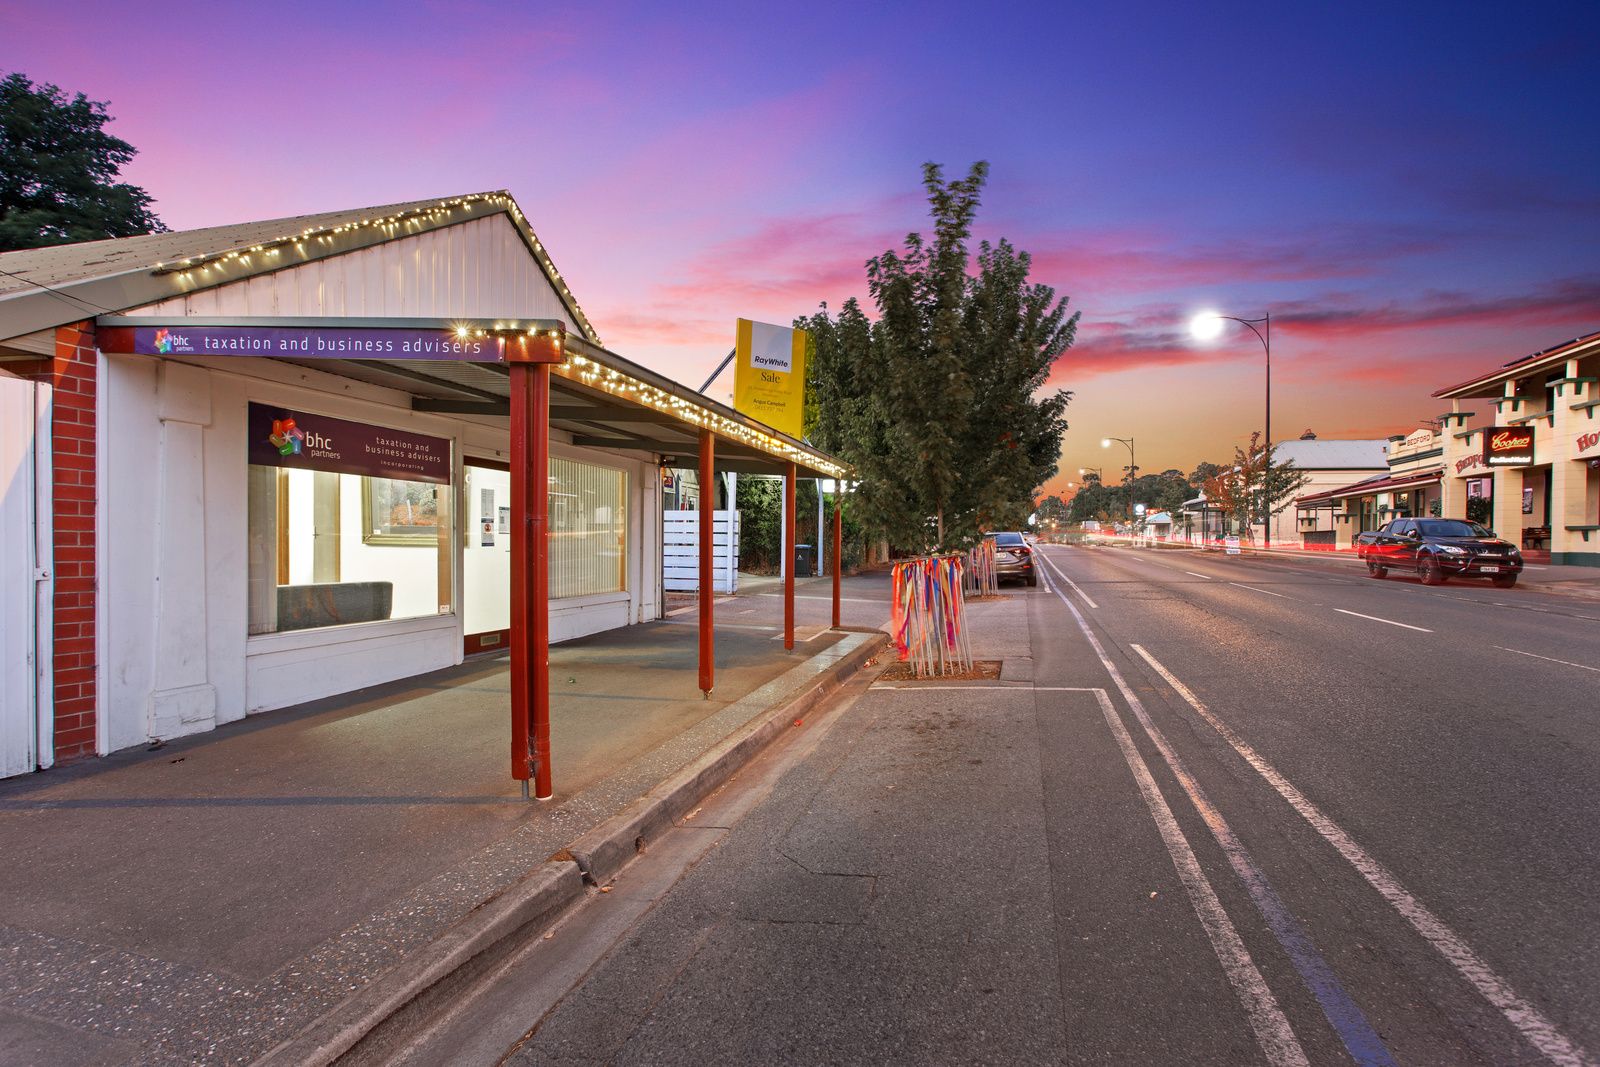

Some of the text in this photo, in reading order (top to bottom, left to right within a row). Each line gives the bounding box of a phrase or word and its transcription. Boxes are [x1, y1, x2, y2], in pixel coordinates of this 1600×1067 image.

[173, 335, 189, 347] bhc
[204, 336, 482, 354] taxation and business advisers
[760, 372, 781, 384] Sale
[305, 431, 332, 450] bhc
[375, 437, 430, 453] taxation and
[1407, 434, 1430, 446] BEDFORD
[1491, 431, 1531, 451] Coopers
[310, 449, 341, 460] partners
[365, 445, 441, 463] business advisers
[380, 460, 425, 471] incorporating
